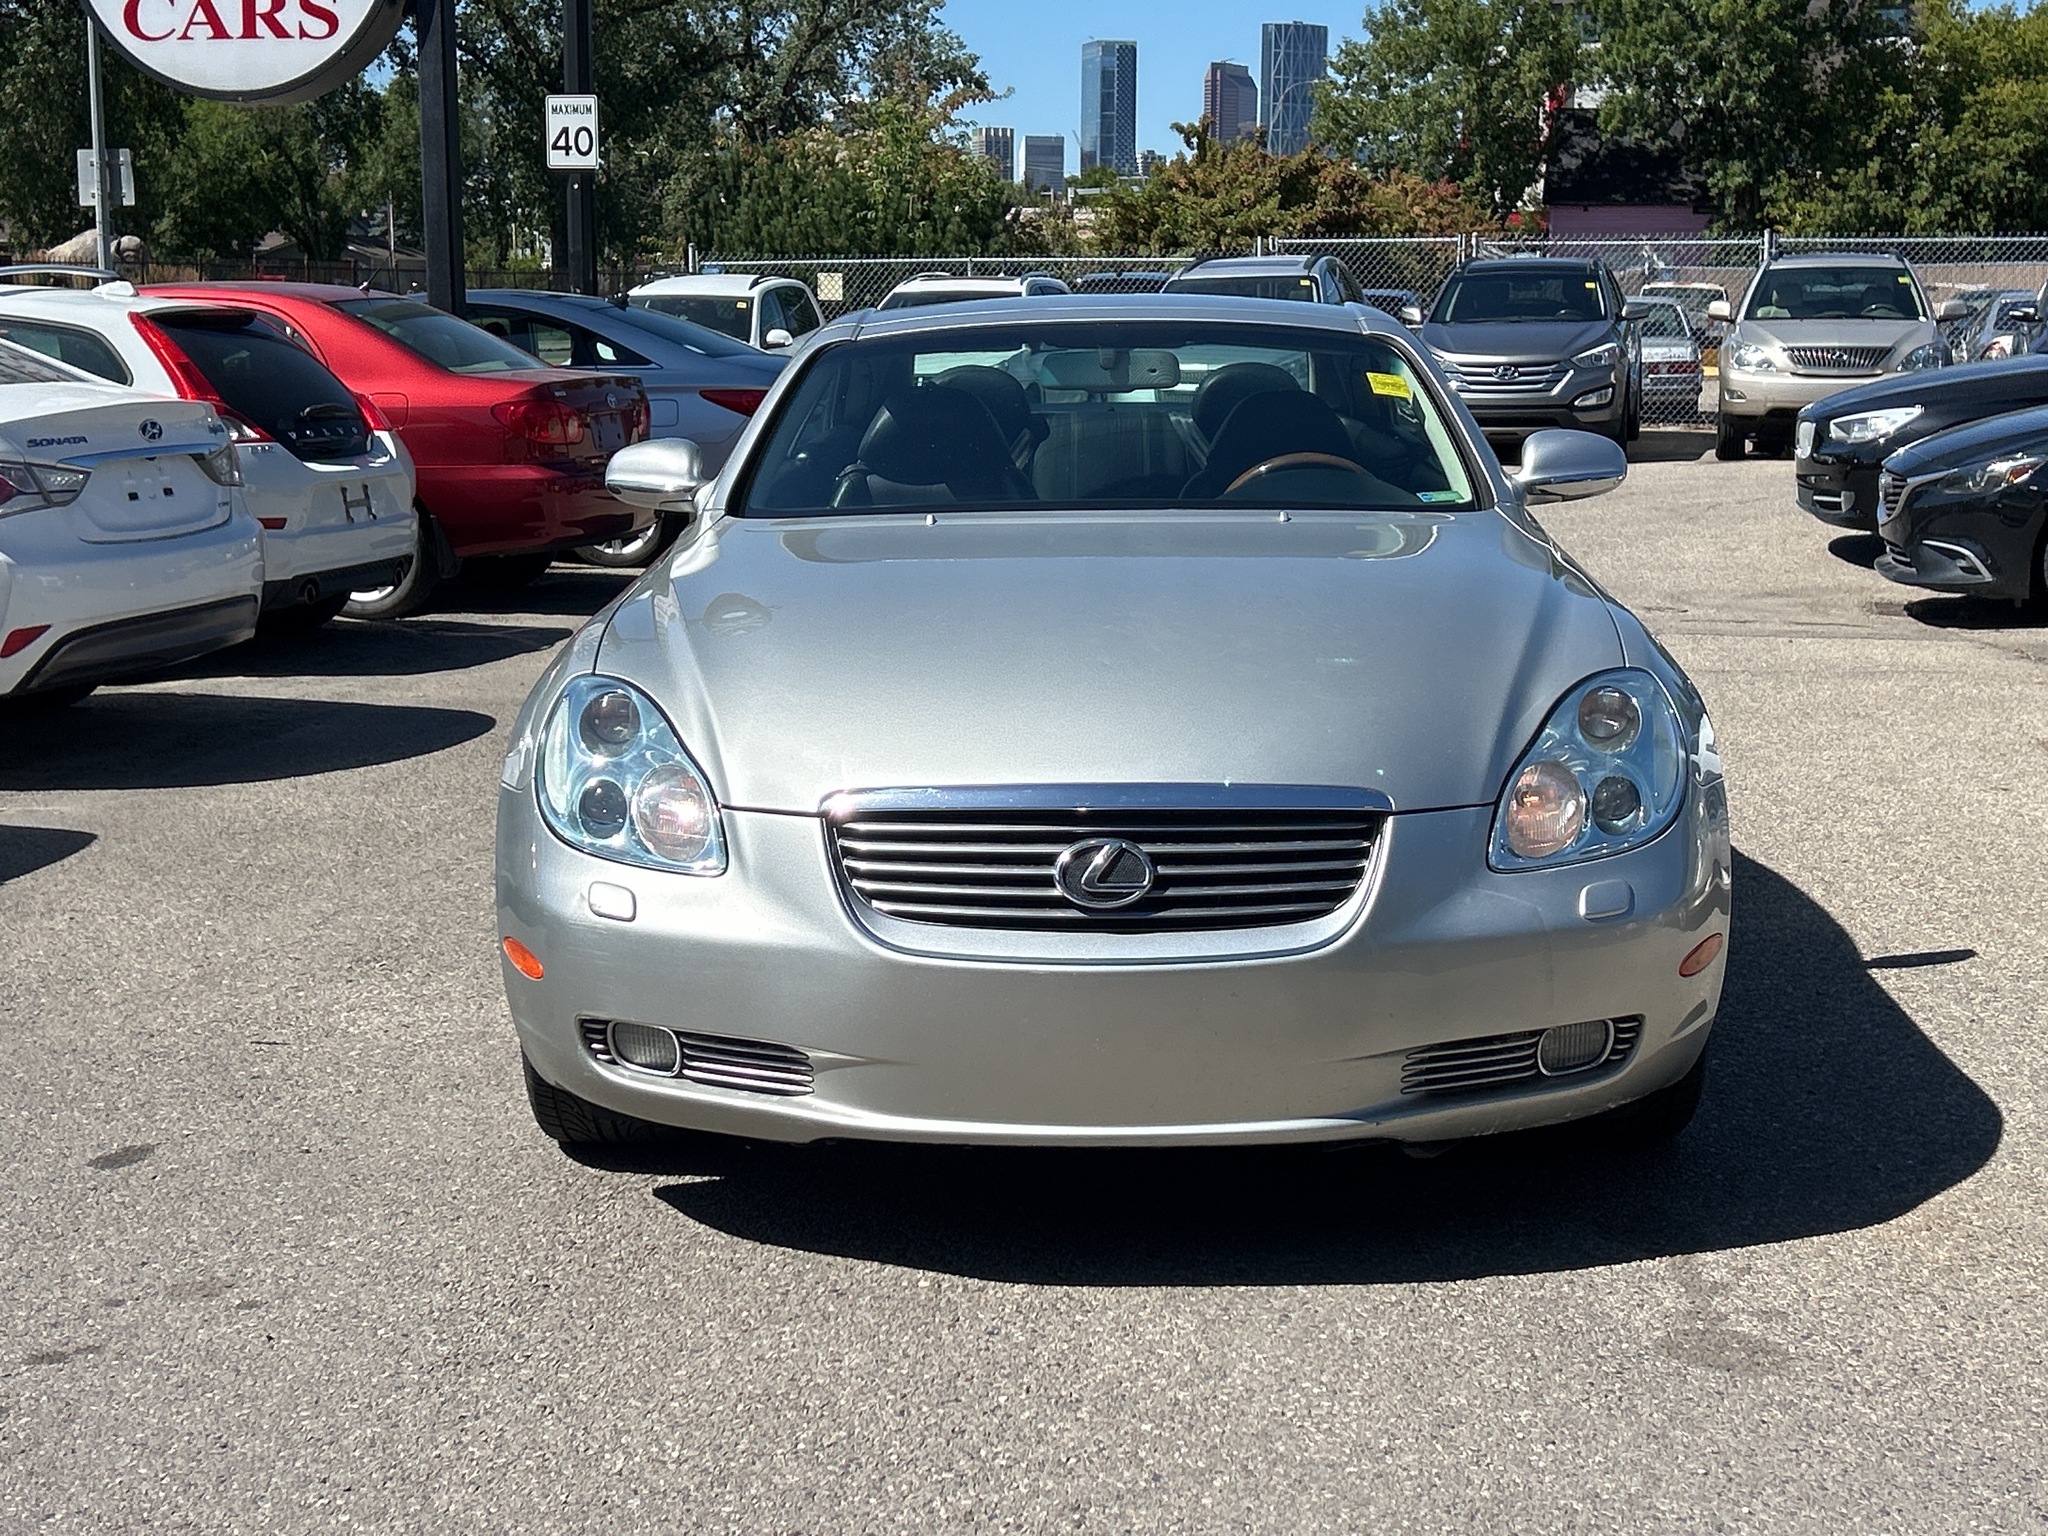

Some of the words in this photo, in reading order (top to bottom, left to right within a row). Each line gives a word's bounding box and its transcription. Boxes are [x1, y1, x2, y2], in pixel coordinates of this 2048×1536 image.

[123, 0, 340, 41] CARS
[551, 104, 593, 115] MAXIMUM
[551, 126, 594, 157] 40
[27, 436, 89, 448] SONATA
